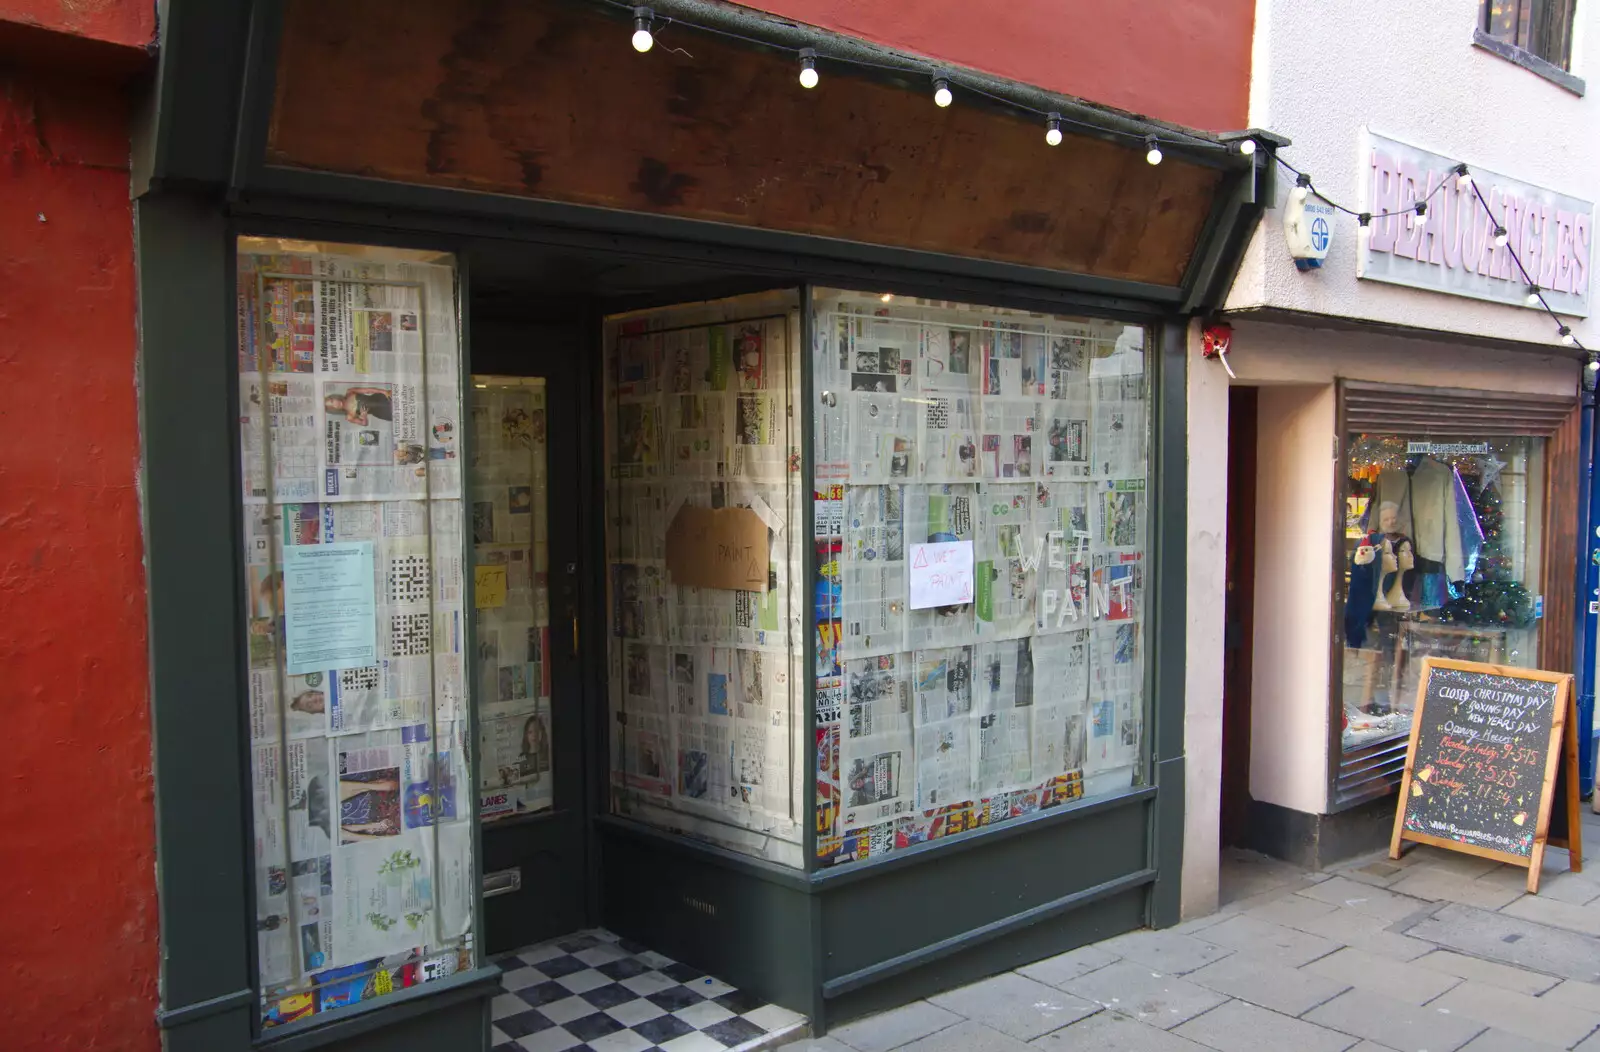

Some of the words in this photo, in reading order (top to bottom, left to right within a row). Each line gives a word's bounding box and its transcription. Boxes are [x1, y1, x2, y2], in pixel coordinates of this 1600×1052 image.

[328, 316, 337, 342] heating
[293, 512, 301, 533] Bulbs
[718, 543, 753, 562] PAINT
[934, 549, 957, 564] WET
[1013, 530, 1092, 572] WET
[930, 571, 965, 588] PAINT
[1042, 575, 1133, 629] PAINT
[1466, 700, 1502, 714] BOXING
[1502, 706, 1525, 720] DAY
[1473, 687, 1524, 706] CHRISTMAS
[1524, 696, 1549, 711] DAY
[1444, 720, 1480, 744] Opening
[1482, 728, 1512, 744] Hours
[1467, 712, 1484, 724] NEW
[1487, 714, 1516, 731] YEARS
[1515, 722, 1541, 734] DAY
